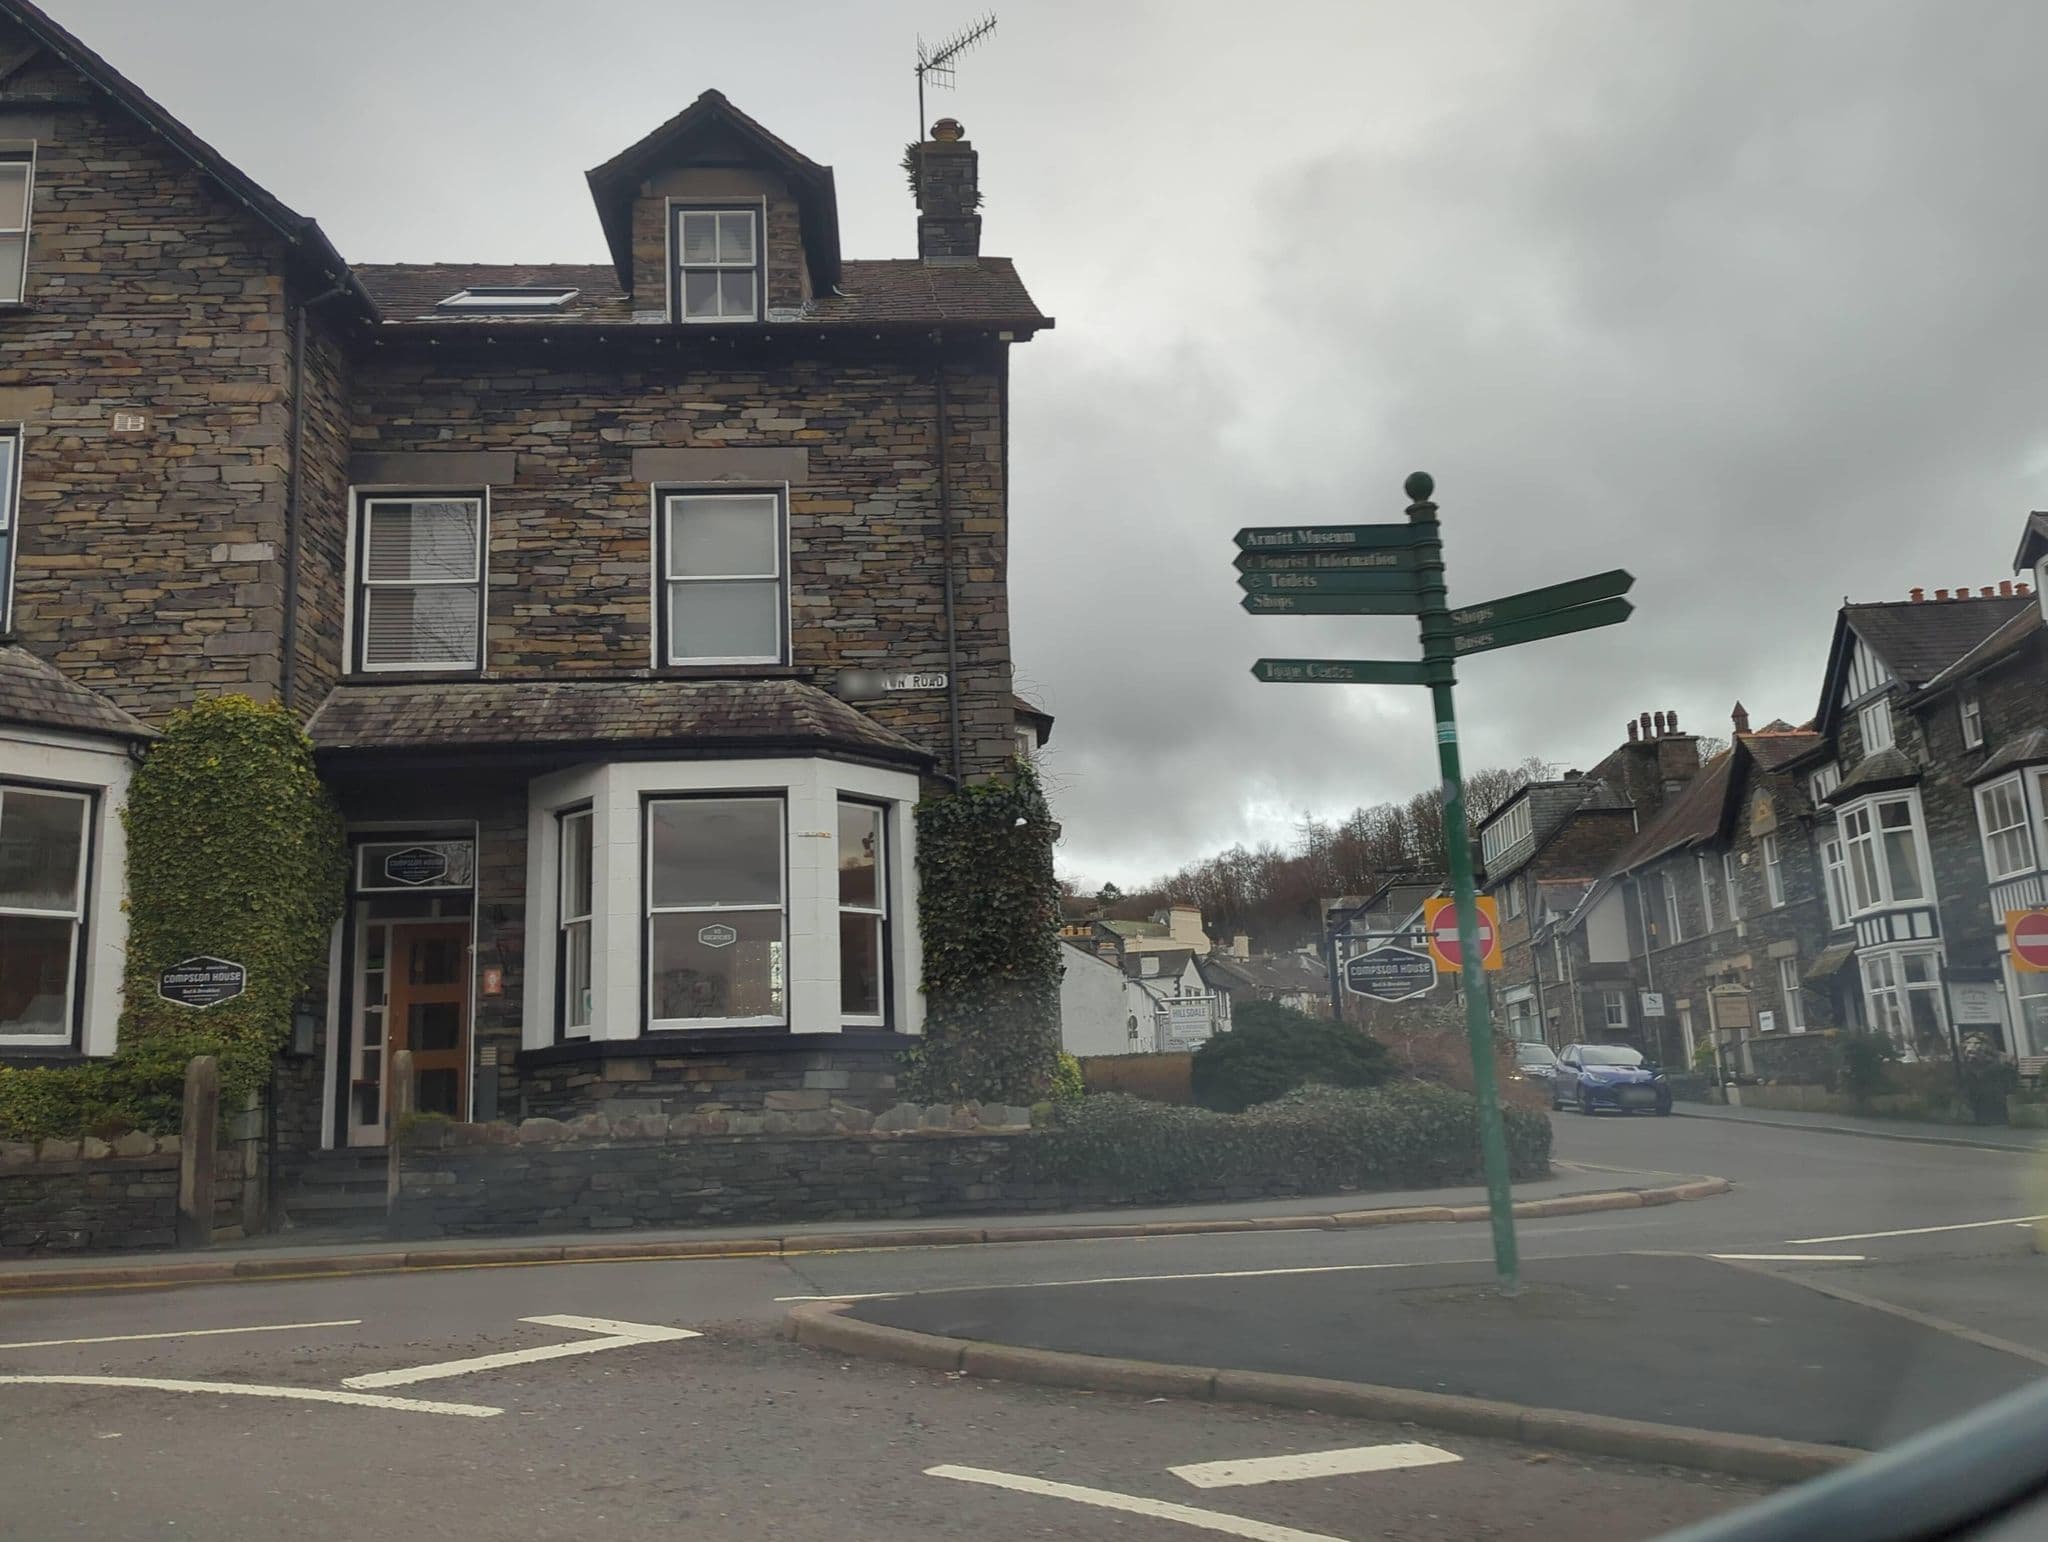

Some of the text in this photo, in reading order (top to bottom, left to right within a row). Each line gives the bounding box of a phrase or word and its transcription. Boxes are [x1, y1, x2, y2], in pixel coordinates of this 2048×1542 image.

[1247, 530, 1356, 545] Armitt Museum
[1260, 554, 1308, 568] Tourist
[1315, 552, 1397, 567] Information
[1269, 574, 1317, 587] Toilets
[1254, 595, 1294, 609] Shops
[1351, 963, 1430, 976] COMPSTON HOUSE
[164, 972, 241, 984] COMPSTON HOUSE
[1173, 1007, 1206, 1017] HILLSDALE
